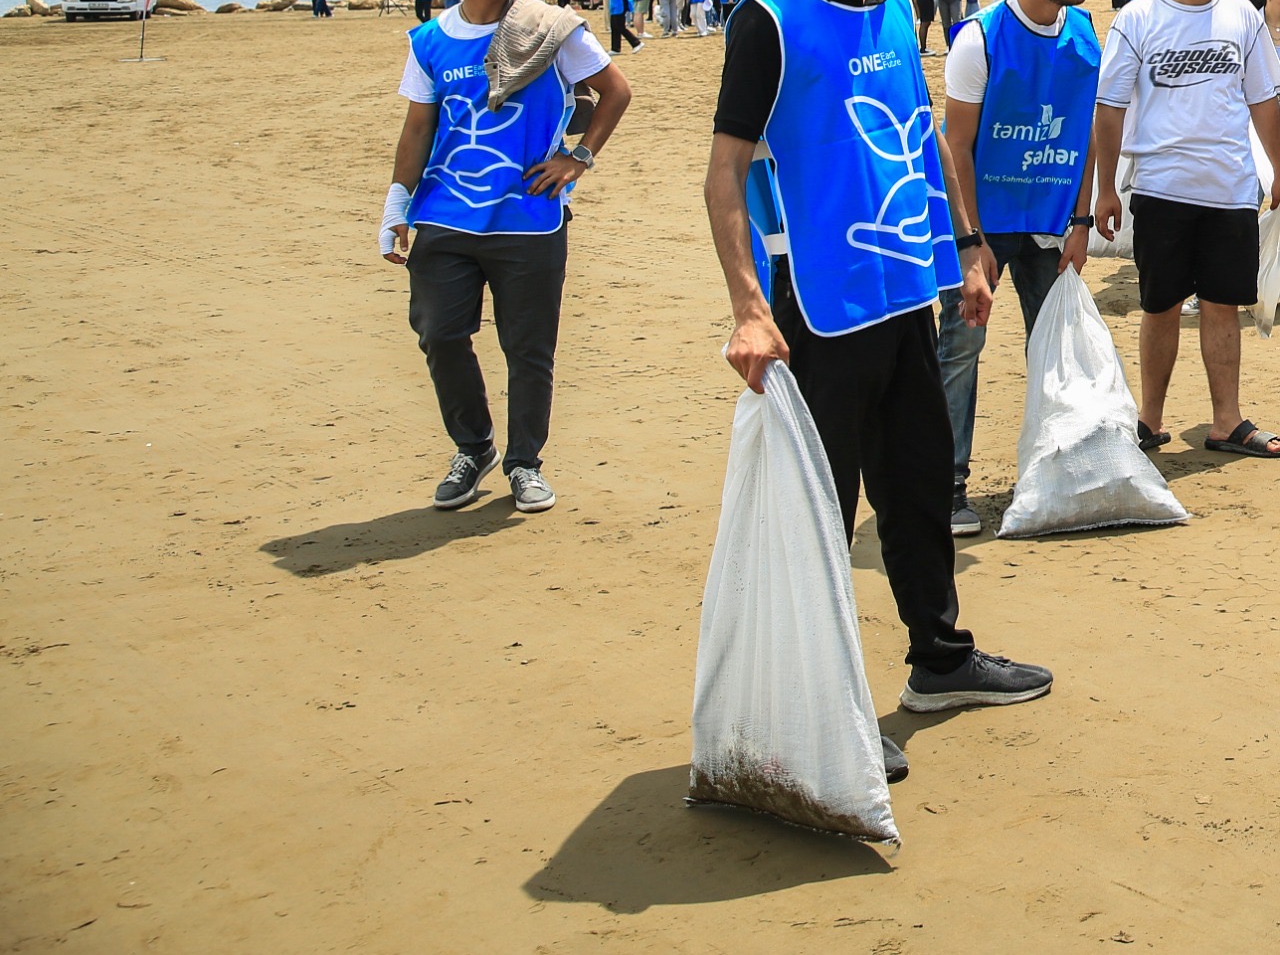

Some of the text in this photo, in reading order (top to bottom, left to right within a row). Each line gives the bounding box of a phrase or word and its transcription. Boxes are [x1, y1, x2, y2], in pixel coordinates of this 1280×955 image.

[848, 53, 884, 76] ONE
[1147, 45, 1236, 65] chaotic
[443, 65, 474, 83] ONE
[1156, 61, 1242, 79] system
[992, 122, 1049, 142] təmiz
[1022, 144, 1079, 172] şəhər
